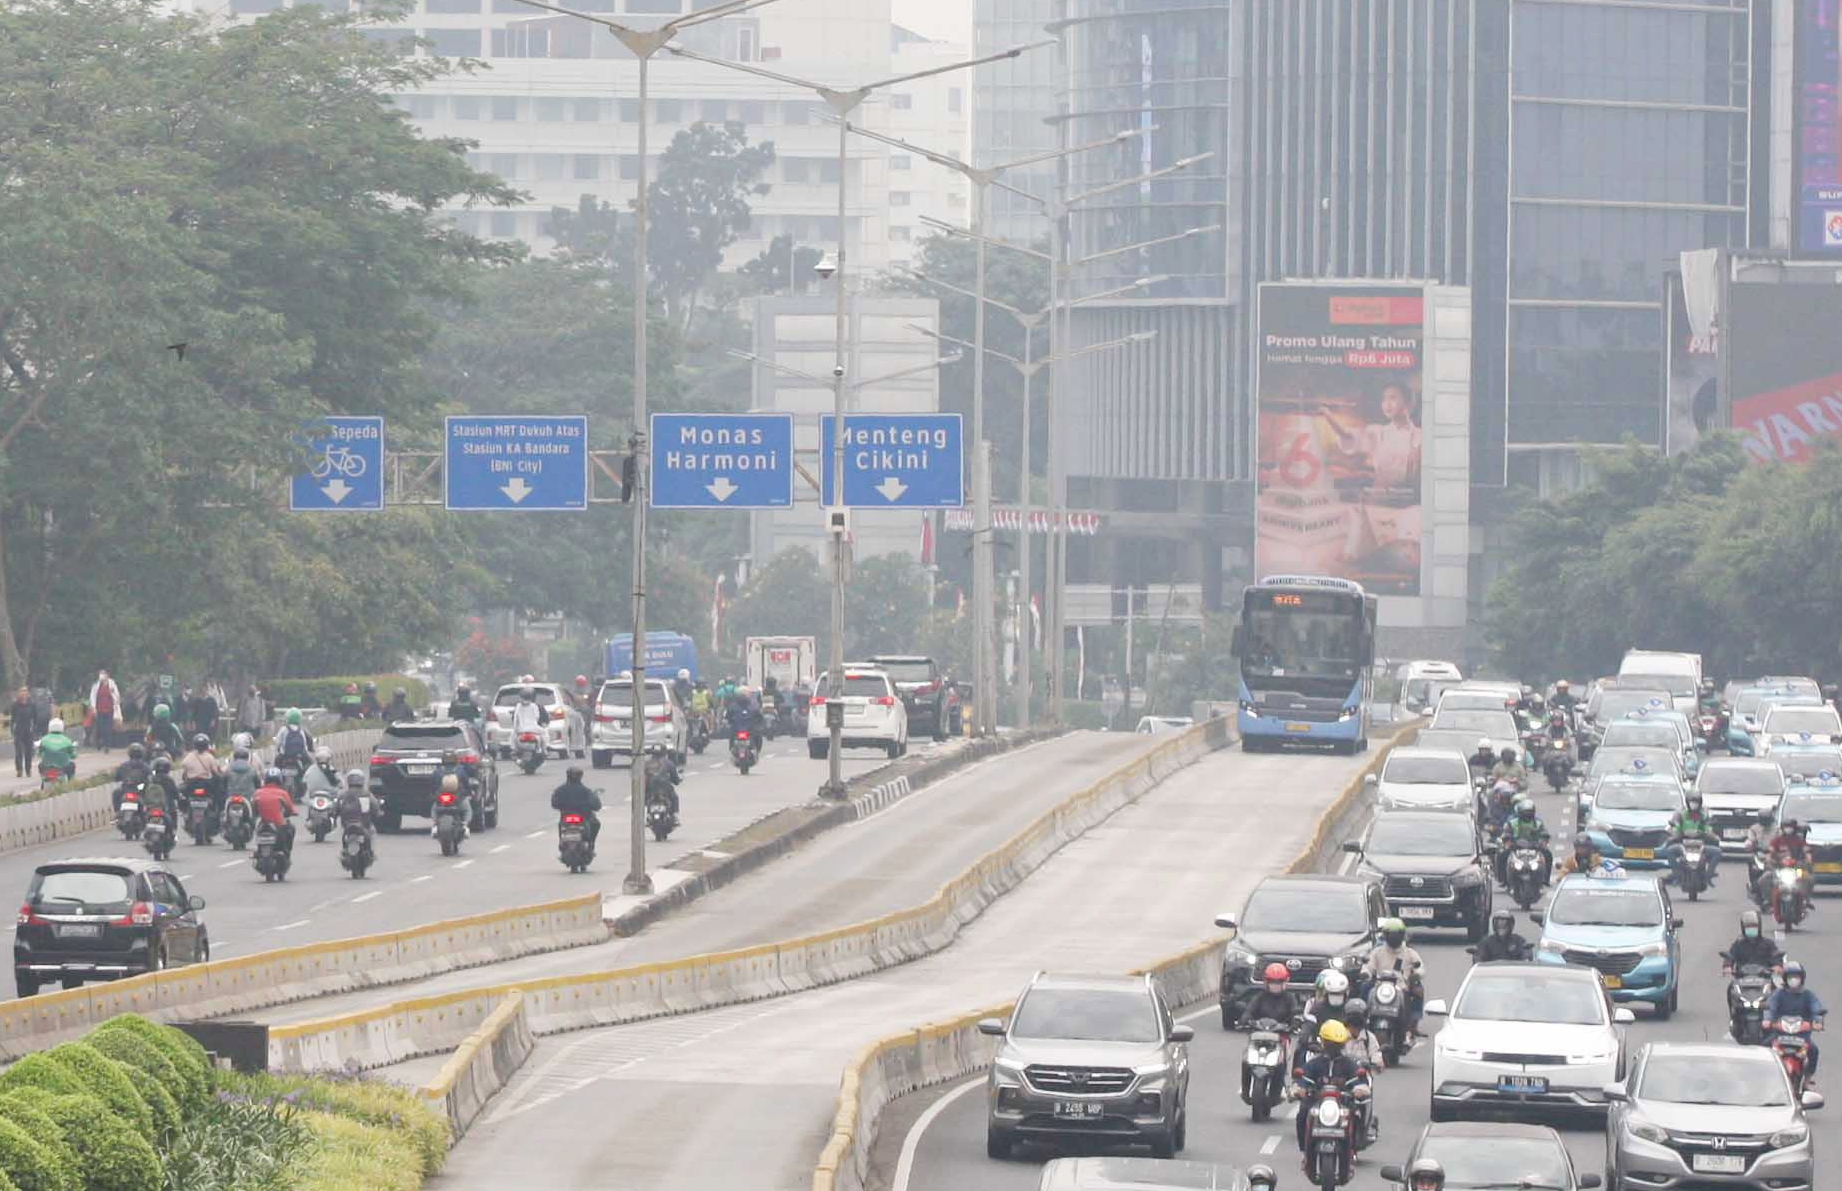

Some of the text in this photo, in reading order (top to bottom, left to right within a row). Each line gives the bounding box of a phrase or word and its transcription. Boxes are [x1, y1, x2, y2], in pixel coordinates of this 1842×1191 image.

[1266, 335, 1416, 350] Promo Ulang Tahun
[1380, 353, 1411, 365] Juta
[453, 425, 580, 437] Stasiun MRT Dukuh Atas
[680, 426, 763, 445] Monas
[463, 443, 570, 455] Stasiun KA Bandara
[517, 459, 543, 473] City)
[666, 451, 777, 470] Harmoni
[856, 451, 928, 470] Cikini
